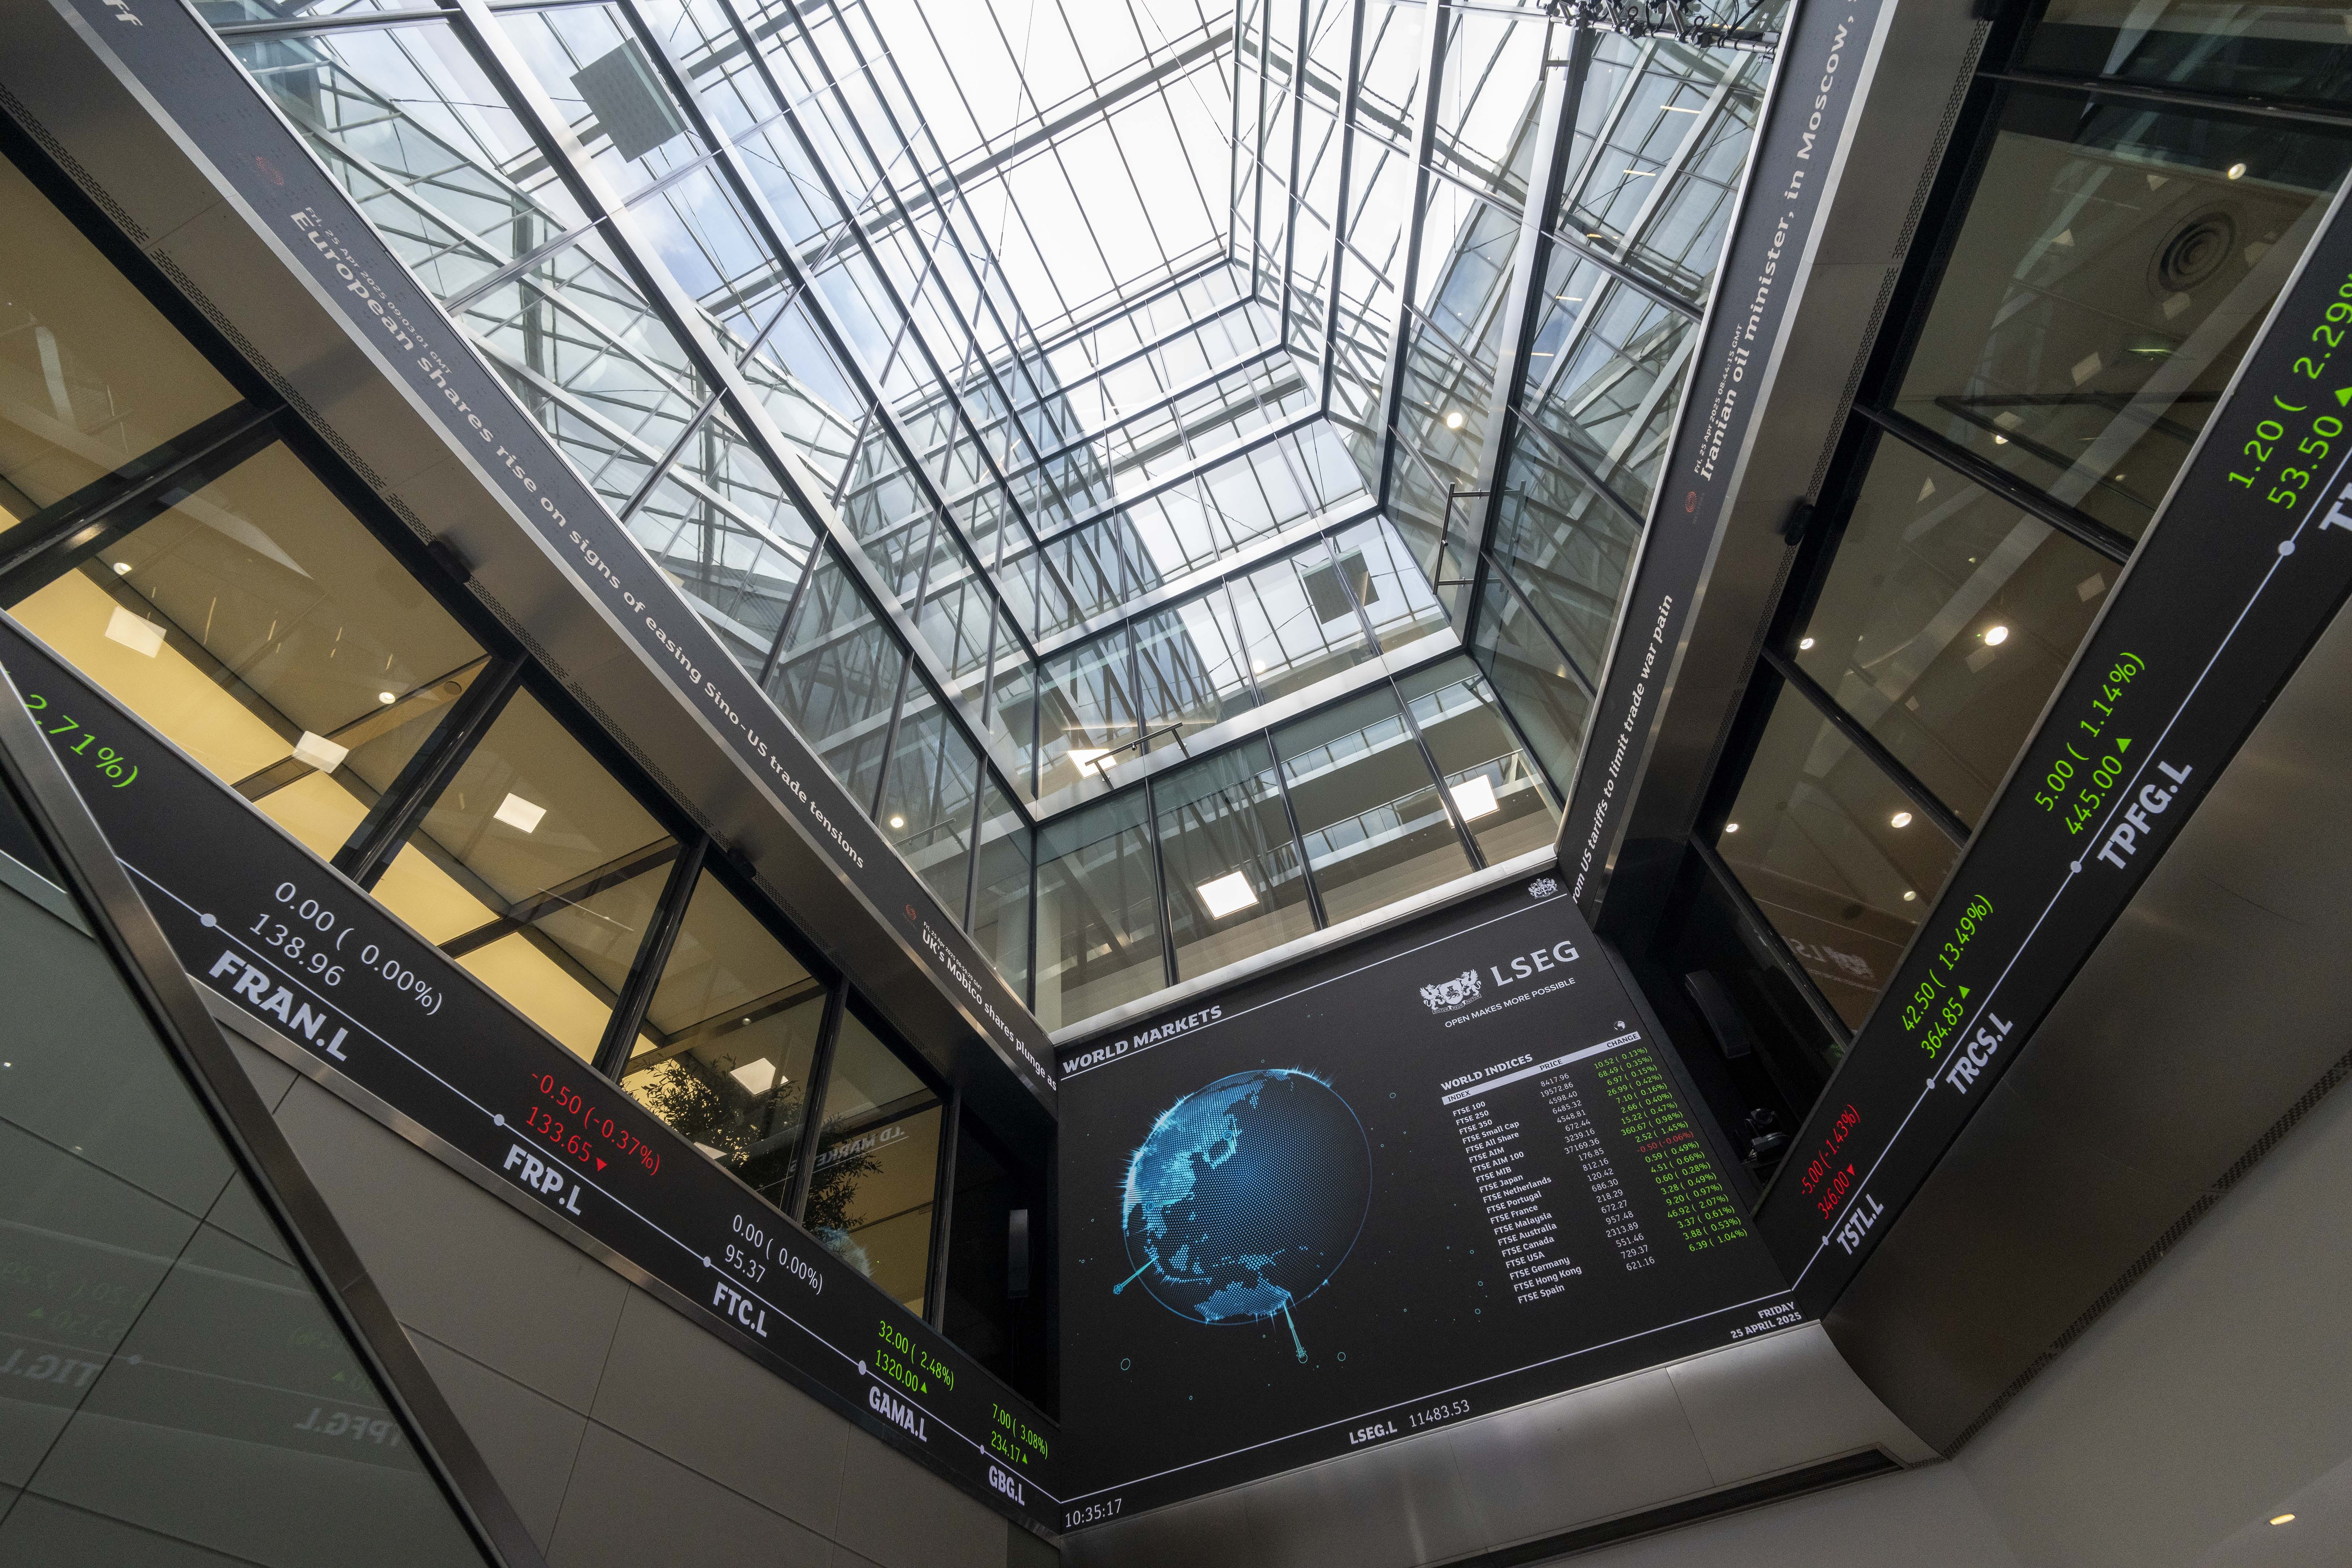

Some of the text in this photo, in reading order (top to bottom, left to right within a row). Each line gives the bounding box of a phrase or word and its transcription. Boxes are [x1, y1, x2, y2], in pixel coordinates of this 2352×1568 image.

[1700, 15, 1854, 481] Iranian oil minister, in Moscow,
[2229, 420, 2284, 488] 1.20
[2267, 415, 2343, 509] 53.50
[290, 211, 863, 868] European shares rise on signs of easing Sino-US trade tensions
[1580, 848, 1592, 872] US
[1587, 799, 1608, 849] tariffs
[1603, 779, 1614, 798] to
[1609, 733, 1628, 778] limit
[1623, 682, 1644, 732] trade
[1641, 642, 1656, 679] war
[1652, 595, 1672, 644] pain
[2034, 760, 2073, 811] 5.00
[2065, 755, 2122, 834] 445.00
[2097, 761, 2192, 869] TPFG.L
[275, 882, 334, 931] 0.00
[249, 913, 345, 986] 138.96
[1490, 940, 1579, 986] LSEG
[208, 950, 348, 1061] FRAN.L
[922, 929, 1056, 1091] UK's Mobico shares plunge as
[1445, 977, 1576, 1027] OPEN MAKES MORE POSSIBLE
[1902, 982, 1935, 1031] 42.50
[1063, 1005, 1222, 1073] WORLD MARKETS
[1921, 997, 1963, 1058] 364.85
[1440, 1053, 1533, 1090] WORLD INDICES
[1447, 1033, 1638, 1102] INDEX PRICE CHANGE
[1593, 1058, 1614, 1069] 10.52
[1945, 1013, 2013, 1094] TRCS.L
[1540, 1073, 1569, 1087] 8417.96
[1549, 1091, 1577, 1104] 4598.40
[532, 1073, 660, 1176] -0.50 (-0.37%)
[1452, 1101, 1485, 1116] FTSE 100
[1458, 1119, 1492, 1135] FTSE 350
[1557, 1109, 1586, 1123] 4548.81
[1621, 1112, 1643, 1124] 15.22
[526, 1106, 592, 1162] 133.65
[1465, 1132, 1519, 1153] FTSE All Share
[1564, 1128, 1595, 1143] 3239.16
[1637, 1130, 1694, 1153] -0.50 (-0.06%)
[1802, 1104, 1860, 1194] -5.00 (-1.43%)
[1472, 1151, 1524, 1173] FTSE AIM 100
[1578, 1148, 1604, 1161] 176.85
[503, 1144, 581, 1216] FRP.L
[1479, 1175, 1523, 1193] FTSE Japan
[1587, 1168, 1614, 1182] 120.42
[1486, 1190, 1542, 1214] FTSE Portugal
[1596, 1189, 1623, 1203] 218.29
[1667, 1205, 1690, 1218] 46.92
[1817, 1170, 1850, 1220] 346.00
[733, 1214, 763, 1247] 0.00
[1494, 1212, 1552, 1235] FTSE Malaysia
[1605, 1210, 1634, 1225] 957.48
[1836, 1193, 1884, 1255] TSTL.L
[1501, 1236, 1555, 1257] FTSE Canada
[1615, 1233, 1644, 1247] 551.46
[725, 1244, 765, 1282] 95.37
[1509, 1257, 1570, 1280] FTSE Germany
[1626, 1256, 1655, 1271] 621.16
[713, 1281, 767, 1337] FTC.L
[1517, 1284, 1565, 1304] FTSE Spain
[1757, 1301, 1794, 1319] FRIDAY
[878, 1320, 908, 1354] 32.00
[1730, 1311, 1802, 1339] 25 APRIL 2025
[875, 1349, 918, 1391] 1320.00
[869, 1386, 927, 1442] GAMA.L
[993, 1403, 1010, 1429] 7.00
[1349, 1399, 1470, 1445] LSEG.L 11483.53
[991, 1430, 1020, 1462] 234.17
[989, 1465, 1025, 1506] GBG.L
[1065, 1498, 1122, 1527] 10:35:17
